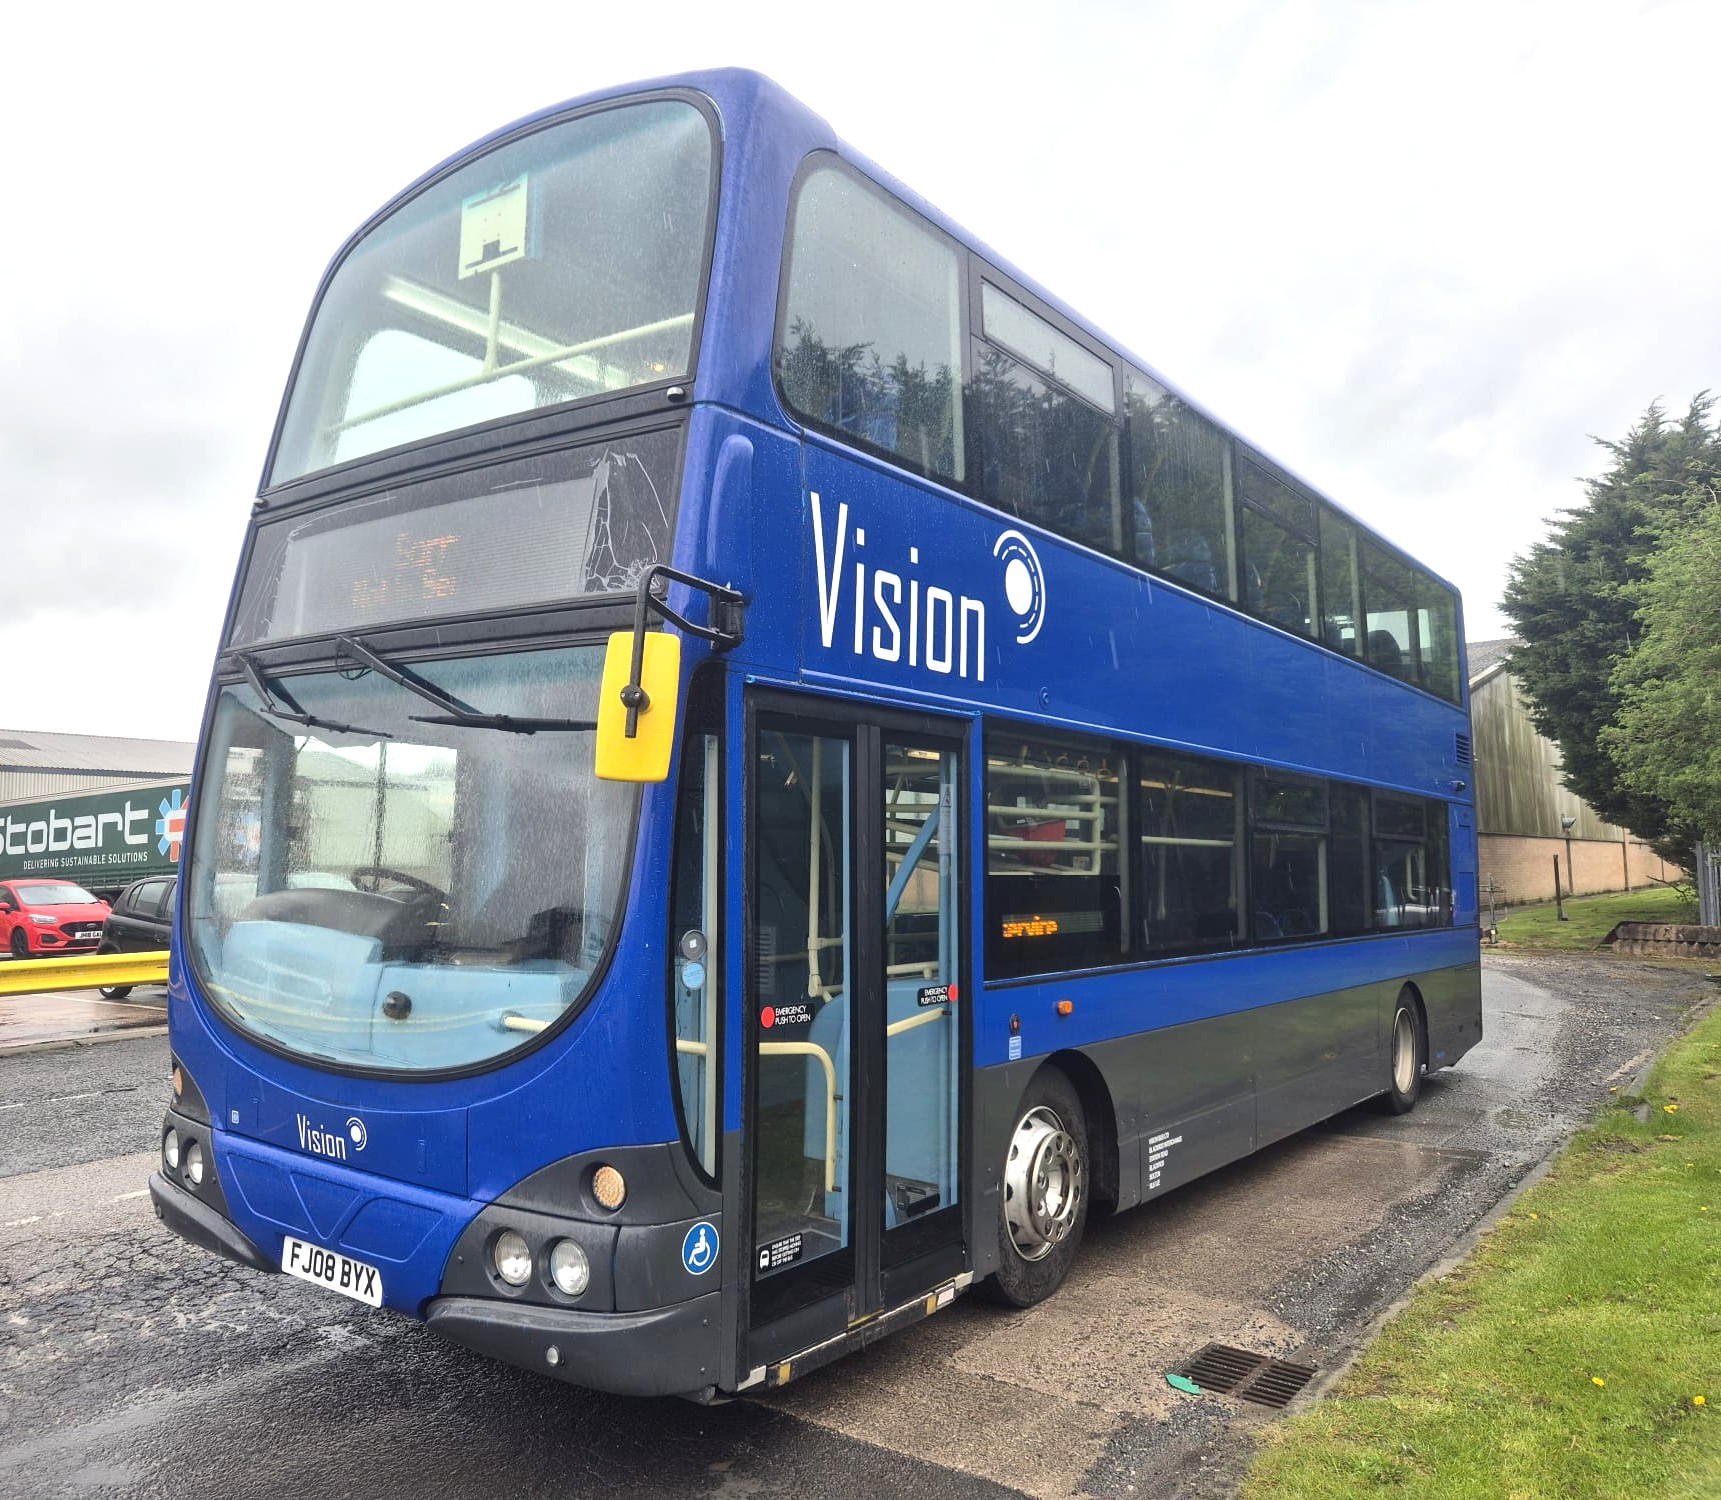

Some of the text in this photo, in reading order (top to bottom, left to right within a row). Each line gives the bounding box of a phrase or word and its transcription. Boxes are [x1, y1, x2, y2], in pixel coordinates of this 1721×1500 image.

[810, 490, 985, 682] Vision
[0, 800, 149, 855] tobart
[23, 851, 148, 870] DELIVERING SUSTAINABLE SOLUTIONS
[924, 986, 948, 996] EMERGENCY
[775, 1005, 807, 1016] EMERGENCY
[775, 1013, 811, 1025] PUSH TO OPEN
[296, 1113, 346, 1160] Vision
[290, 1241, 376, 1298] FJ08 BYX
